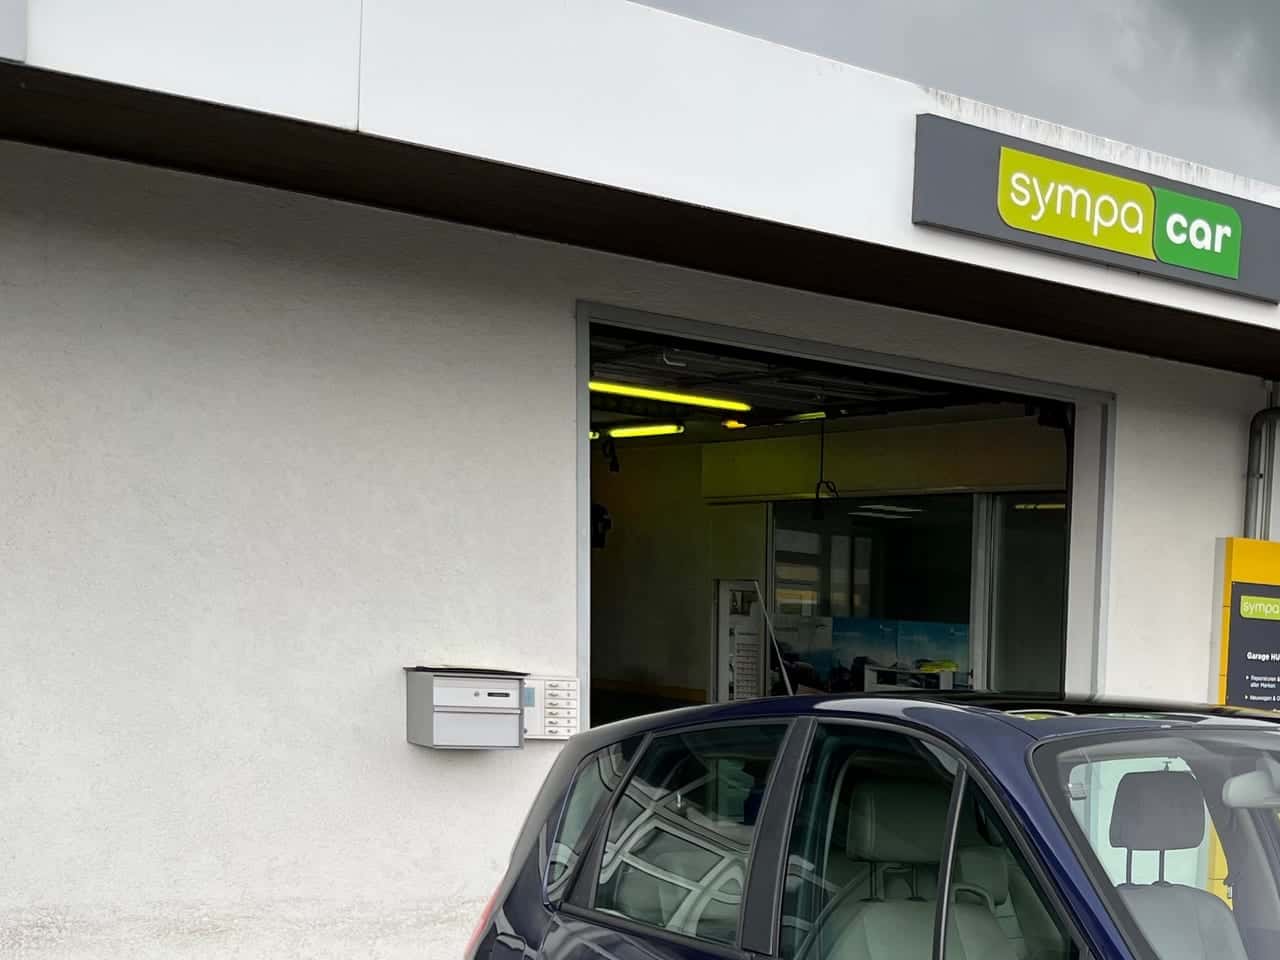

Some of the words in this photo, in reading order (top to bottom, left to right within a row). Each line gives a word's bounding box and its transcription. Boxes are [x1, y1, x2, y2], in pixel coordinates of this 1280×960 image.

[1010, 171, 1144, 236] sympa
[1166, 212, 1231, 254] car
[1243, 601, 1280, 616] sympa
[1246, 651, 1270, 662] Garage
